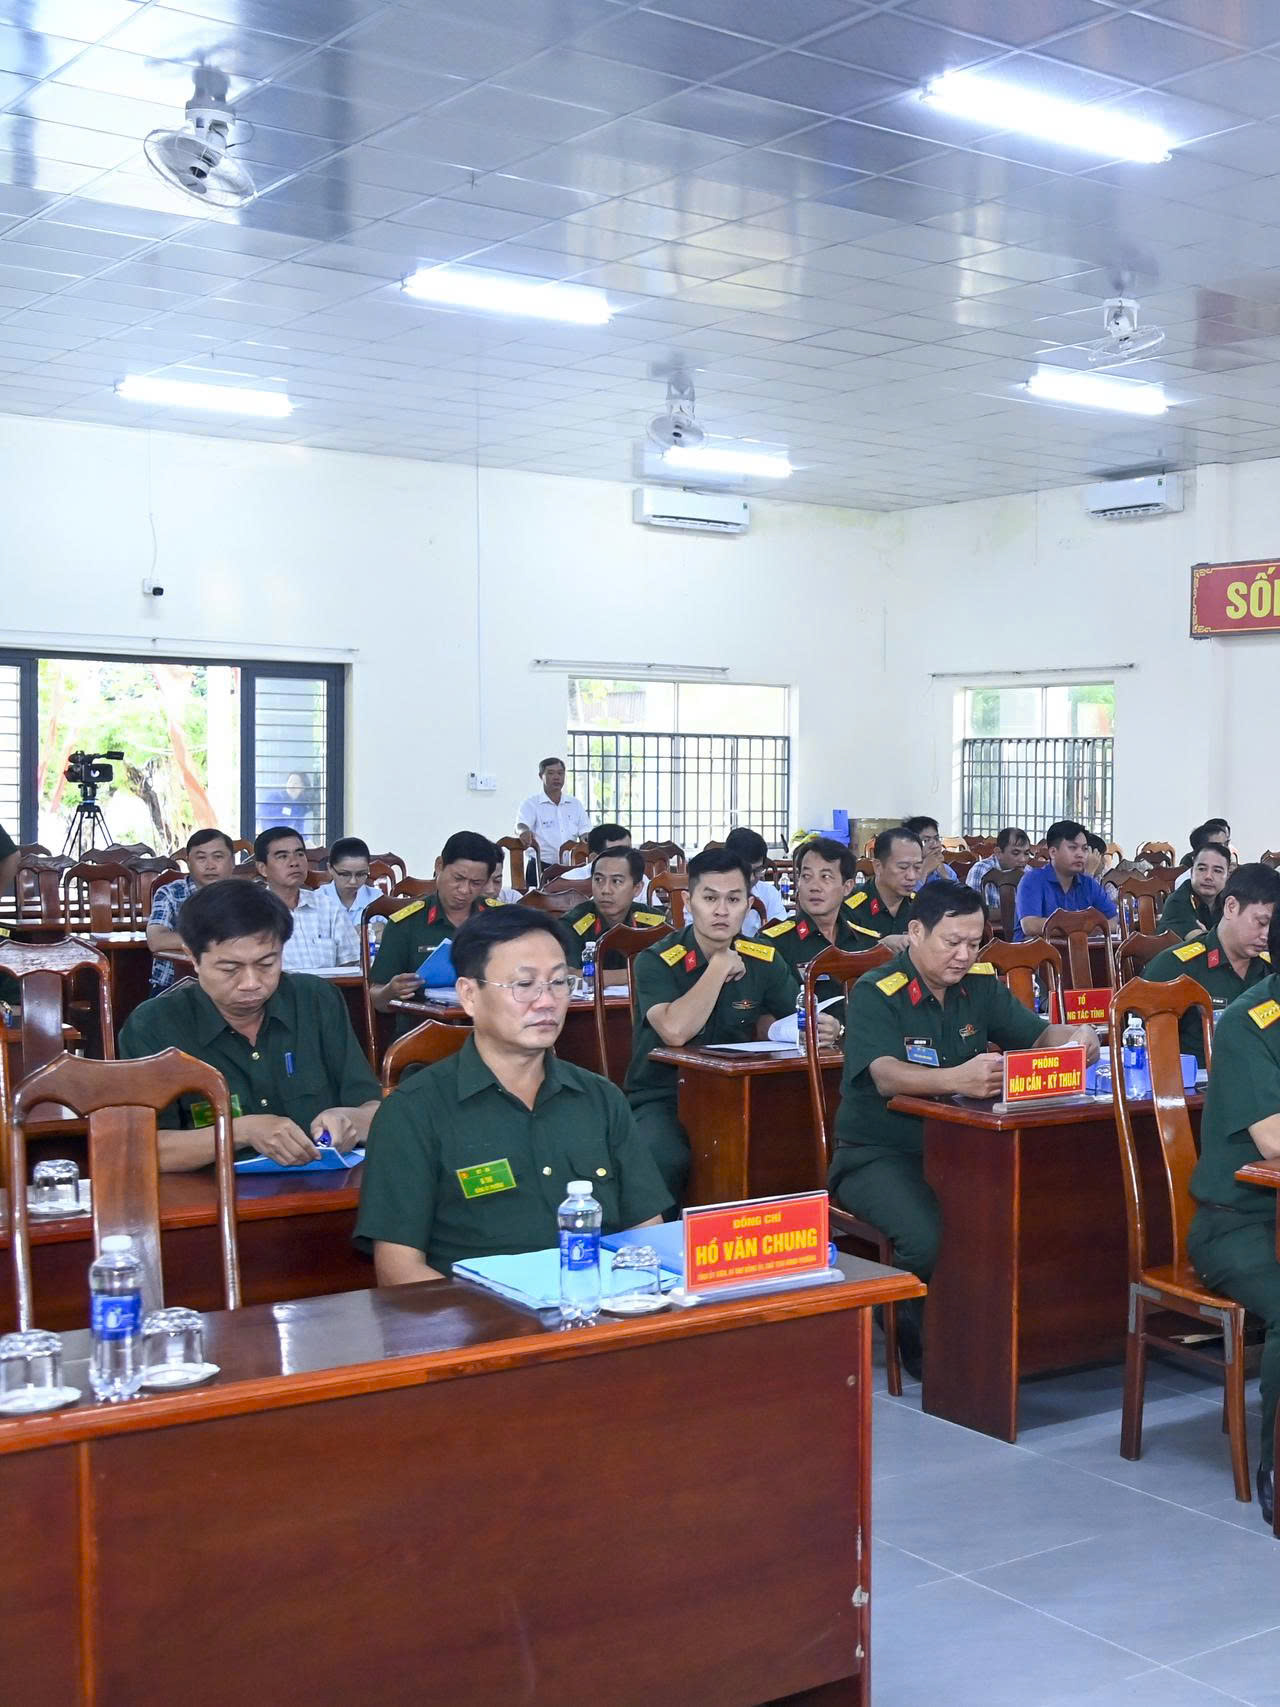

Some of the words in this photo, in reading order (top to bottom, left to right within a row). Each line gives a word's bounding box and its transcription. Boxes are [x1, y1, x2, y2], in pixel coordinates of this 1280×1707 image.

[1032, 1056, 1060, 1070] PHÒNG
[1059, 1069, 1081, 1090] THUẬT
[696, 1237, 719, 1266] HỒ
[723, 1236, 758, 1261] VĂN
[762, 1228, 818, 1256] CHUNG
